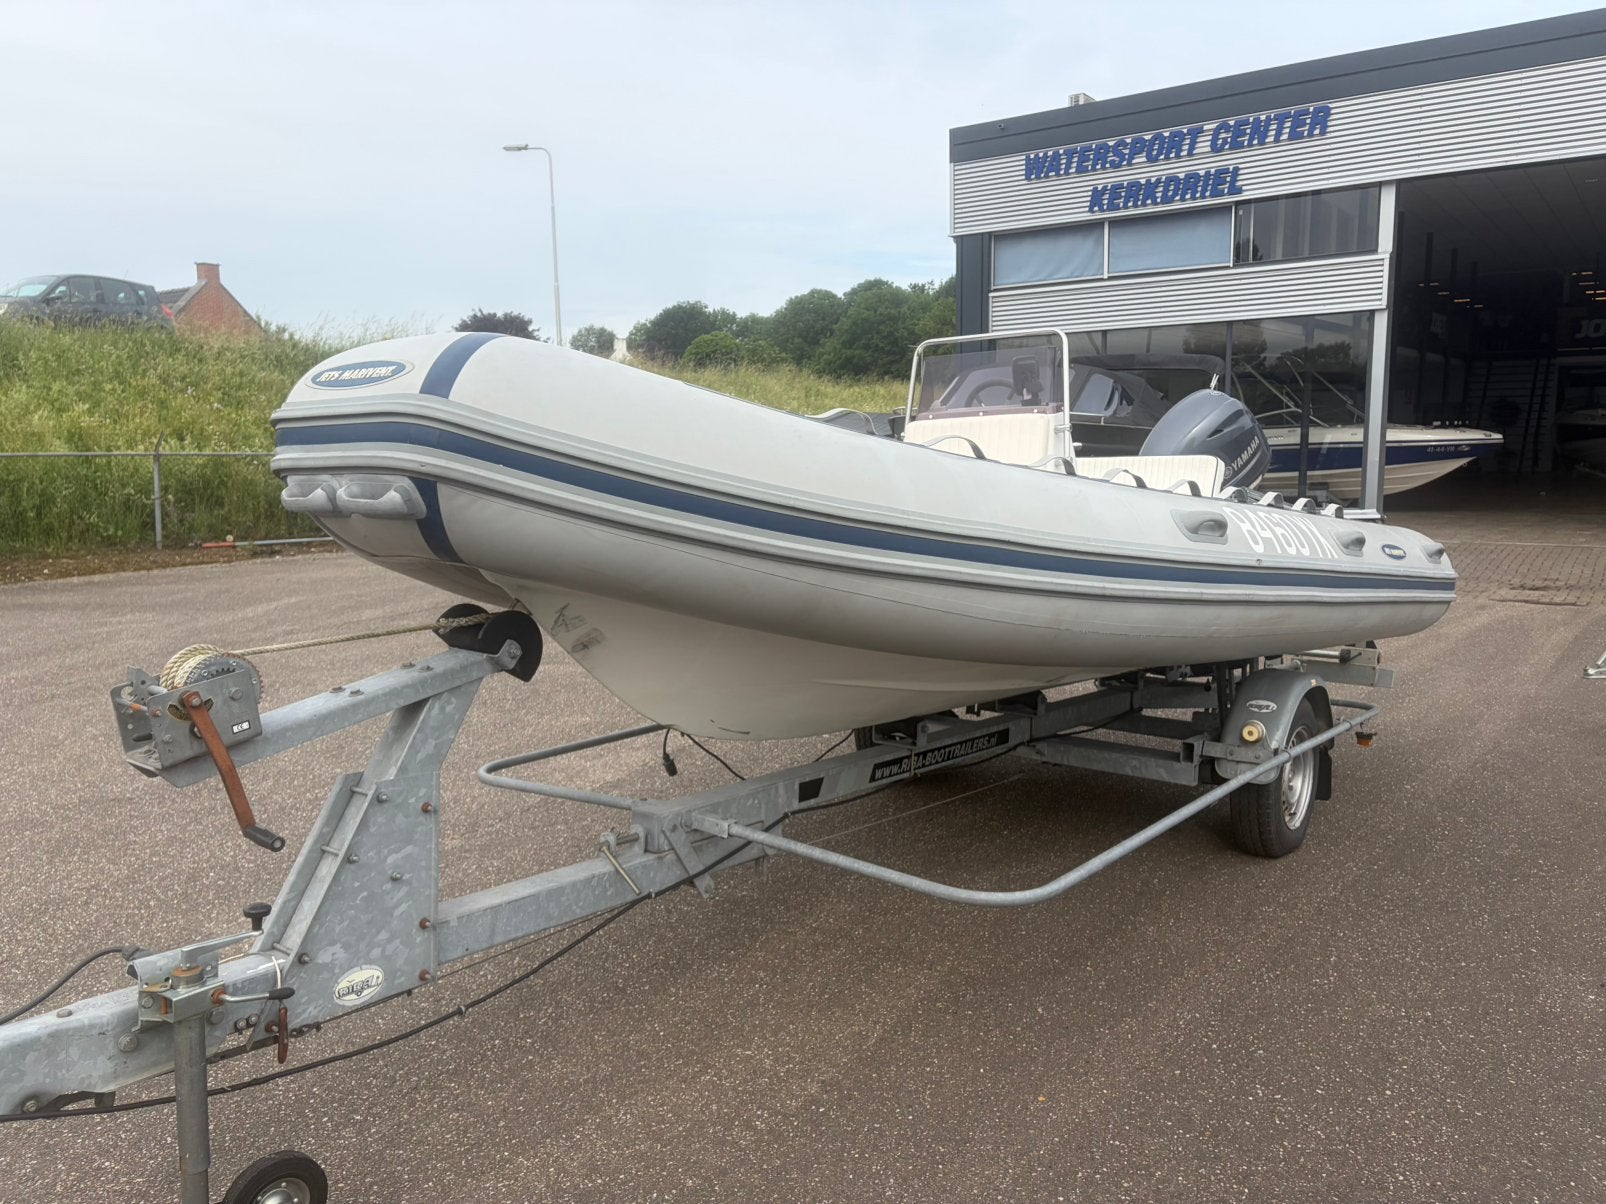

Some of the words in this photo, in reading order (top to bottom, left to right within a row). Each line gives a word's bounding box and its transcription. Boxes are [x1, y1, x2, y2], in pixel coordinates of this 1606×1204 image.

[1024, 125, 1204, 181] WATERSPORT
[1210, 104, 1332, 153] CENTER
[1088, 166, 1243, 214] KERKDRIEL
[1231, 435, 1260, 471] YAMAHA
